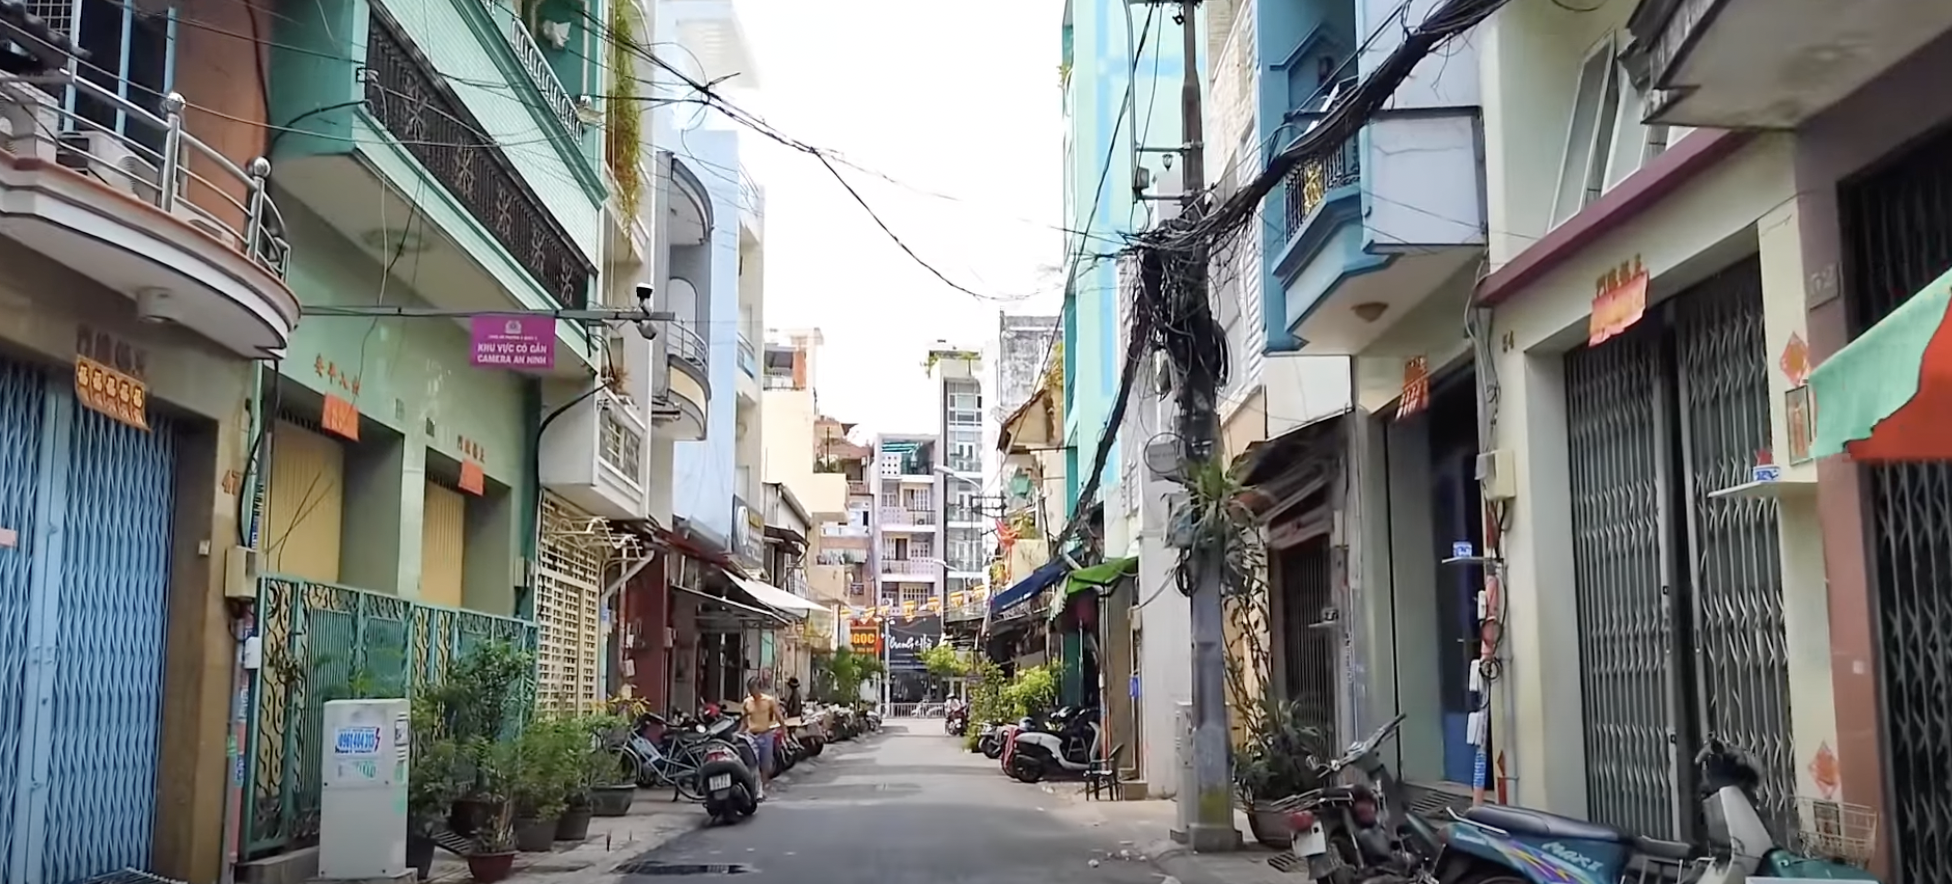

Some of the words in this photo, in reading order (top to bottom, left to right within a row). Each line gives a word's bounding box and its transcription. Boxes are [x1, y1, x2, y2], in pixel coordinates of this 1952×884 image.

[477, 343, 496, 353] KHU
[497, 343, 515, 354] VỰC
[516, 343, 528, 353] CÓ
[529, 341, 548, 354] GẮN
[477, 354, 512, 364] CAMERA
[513, 355, 526, 364] AN
[526, 355, 548, 365] NINH
